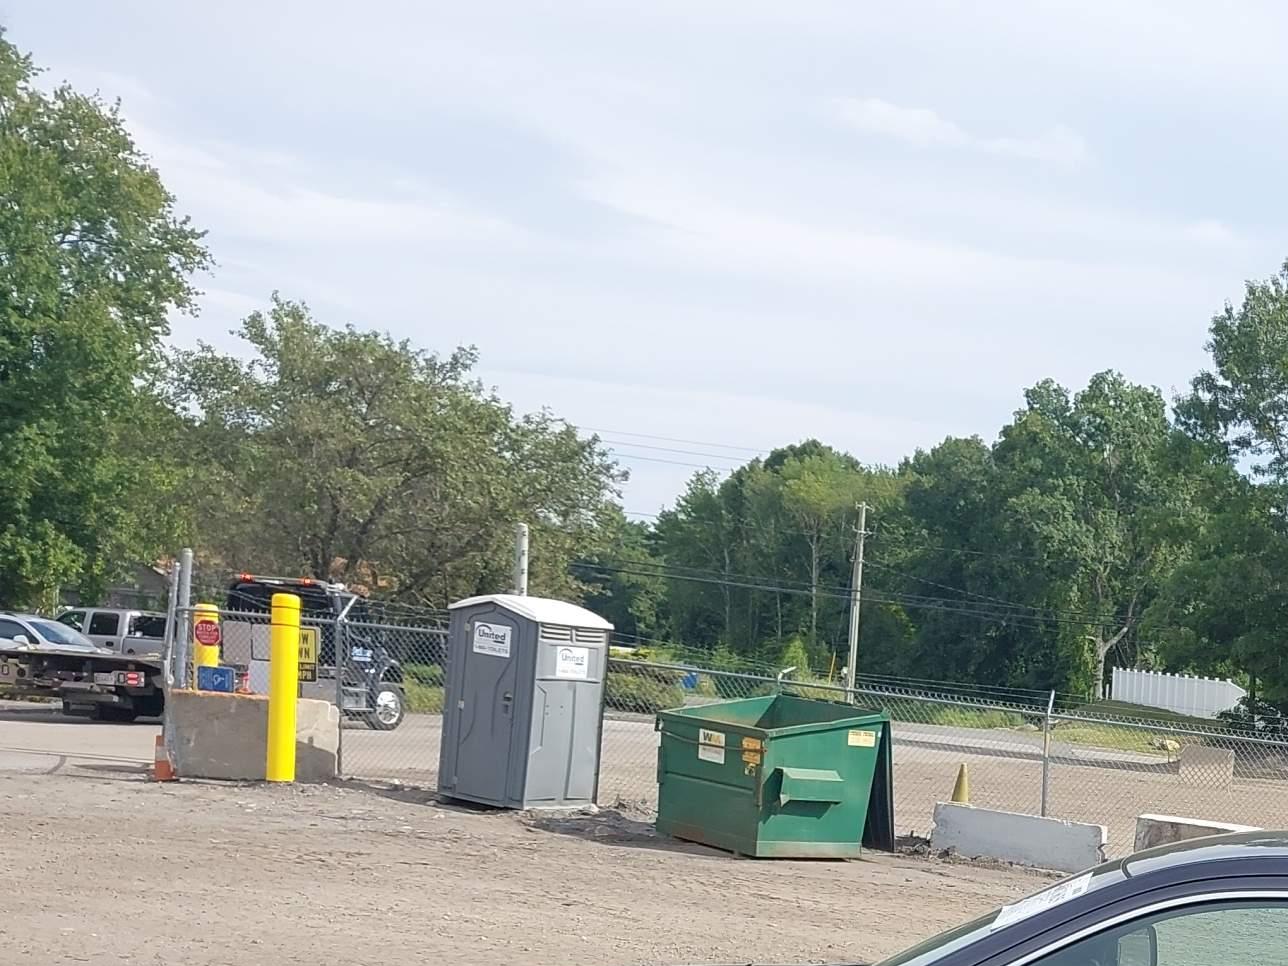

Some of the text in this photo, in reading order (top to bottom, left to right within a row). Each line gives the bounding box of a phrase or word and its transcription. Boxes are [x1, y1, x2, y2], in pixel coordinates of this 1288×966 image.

[198, 623, 216, 632] STOP
[478, 629, 506, 641] United
[561, 652, 585, 663] United
